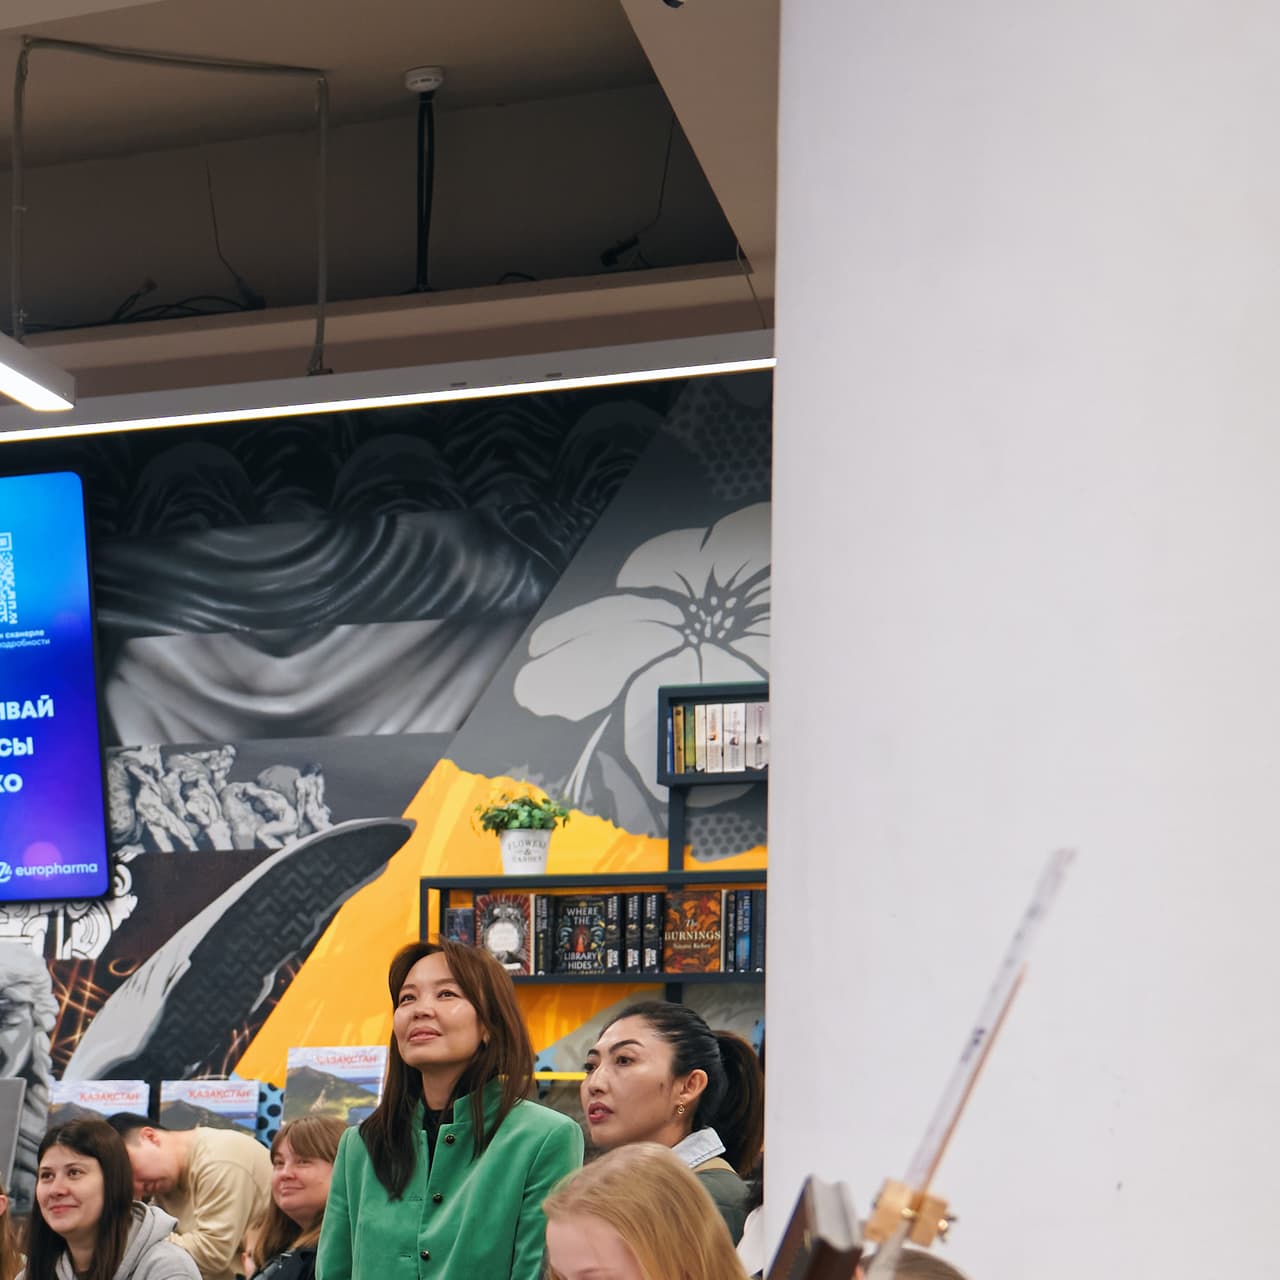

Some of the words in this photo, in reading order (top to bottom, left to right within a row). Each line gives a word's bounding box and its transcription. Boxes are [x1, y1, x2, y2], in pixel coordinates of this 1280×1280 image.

[15, 863, 98, 878] europharma
[566, 906, 599, 917] WHERE
[573, 916, 591, 925] THE
[664, 930, 721, 941] BURNINGS
[564, 951, 597, 961] LIBRARY
[568, 961, 592, 970] HIDES
